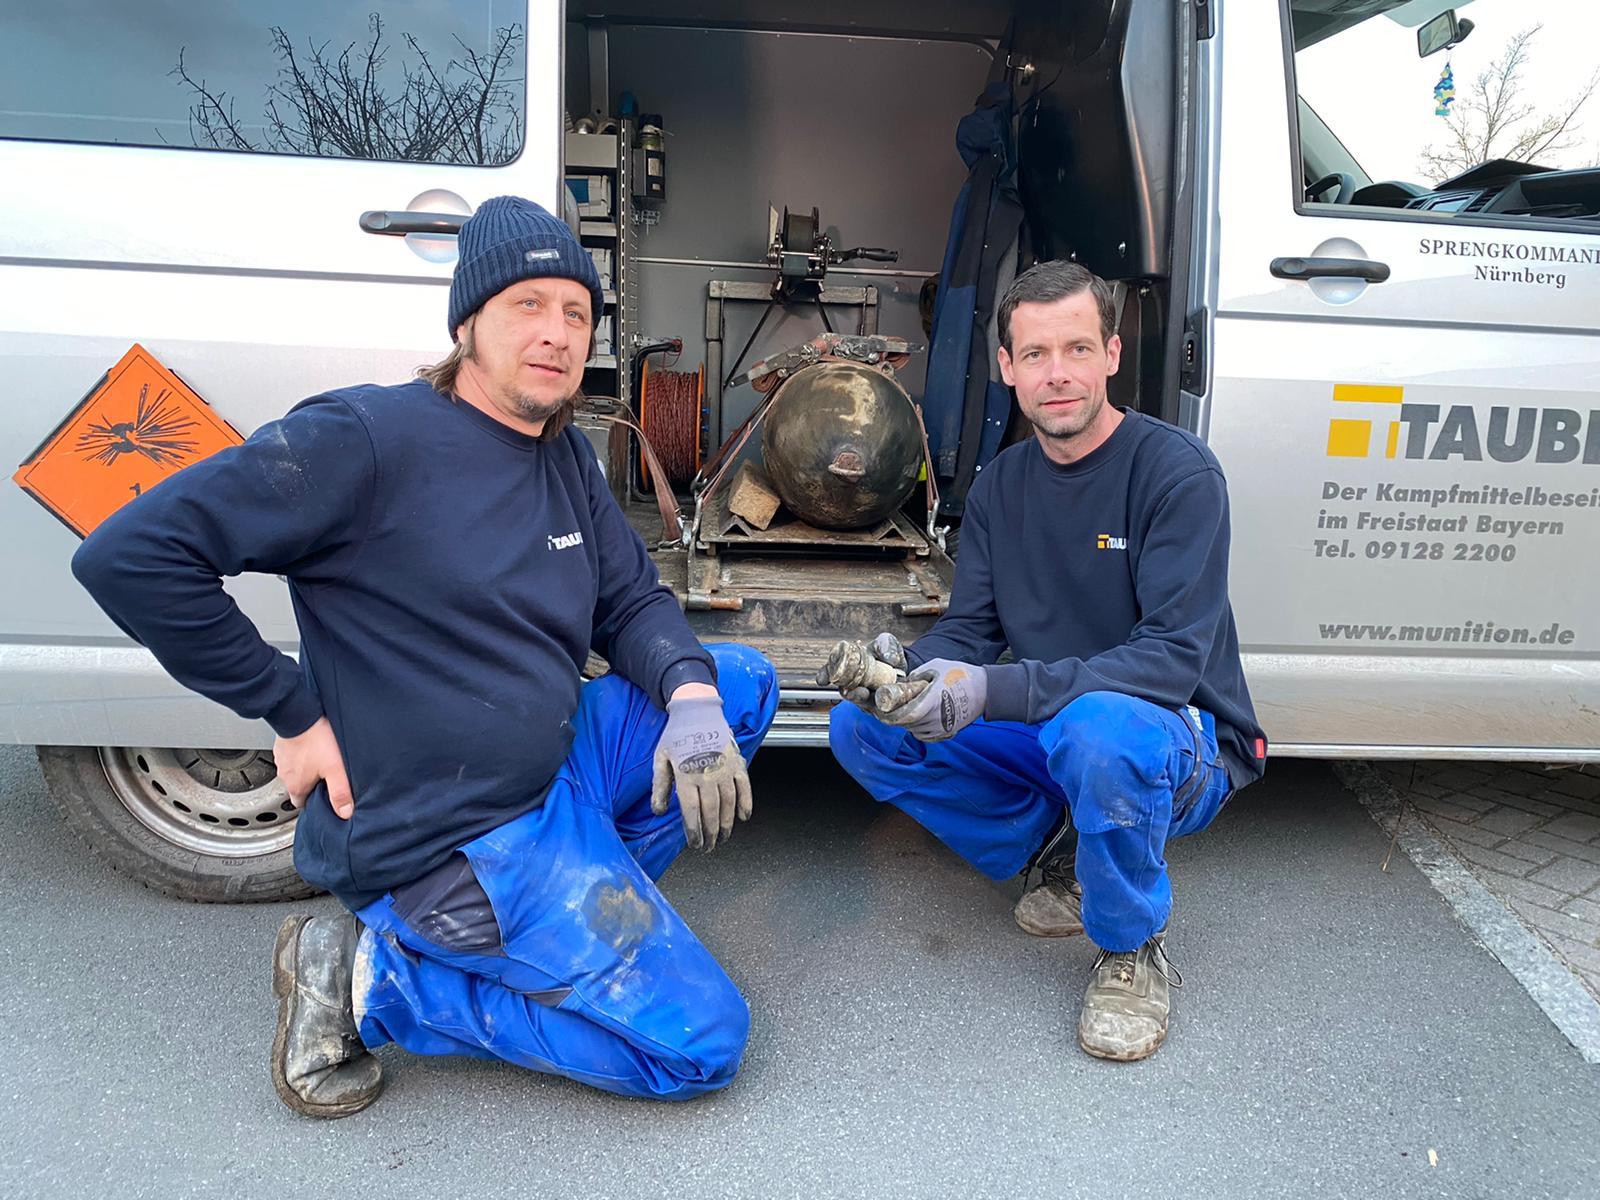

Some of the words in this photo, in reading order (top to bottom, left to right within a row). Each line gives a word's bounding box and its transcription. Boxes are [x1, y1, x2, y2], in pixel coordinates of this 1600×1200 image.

[1474, 265, 1566, 289] Nürnberg
[1321, 481, 1368, 501] Der
[1375, 483, 1600, 508] Kampfmittelbesei
[1317, 509, 1348, 529] im
[1356, 511, 1468, 532] Freistaat
[1475, 515, 1565, 538] Bayern
[1313, 539, 1356, 558] Tel.
[1364, 541, 1445, 560] 09128
[1452, 543, 1517, 562] 2200
[1318, 620, 1576, 645] www.munition.de
